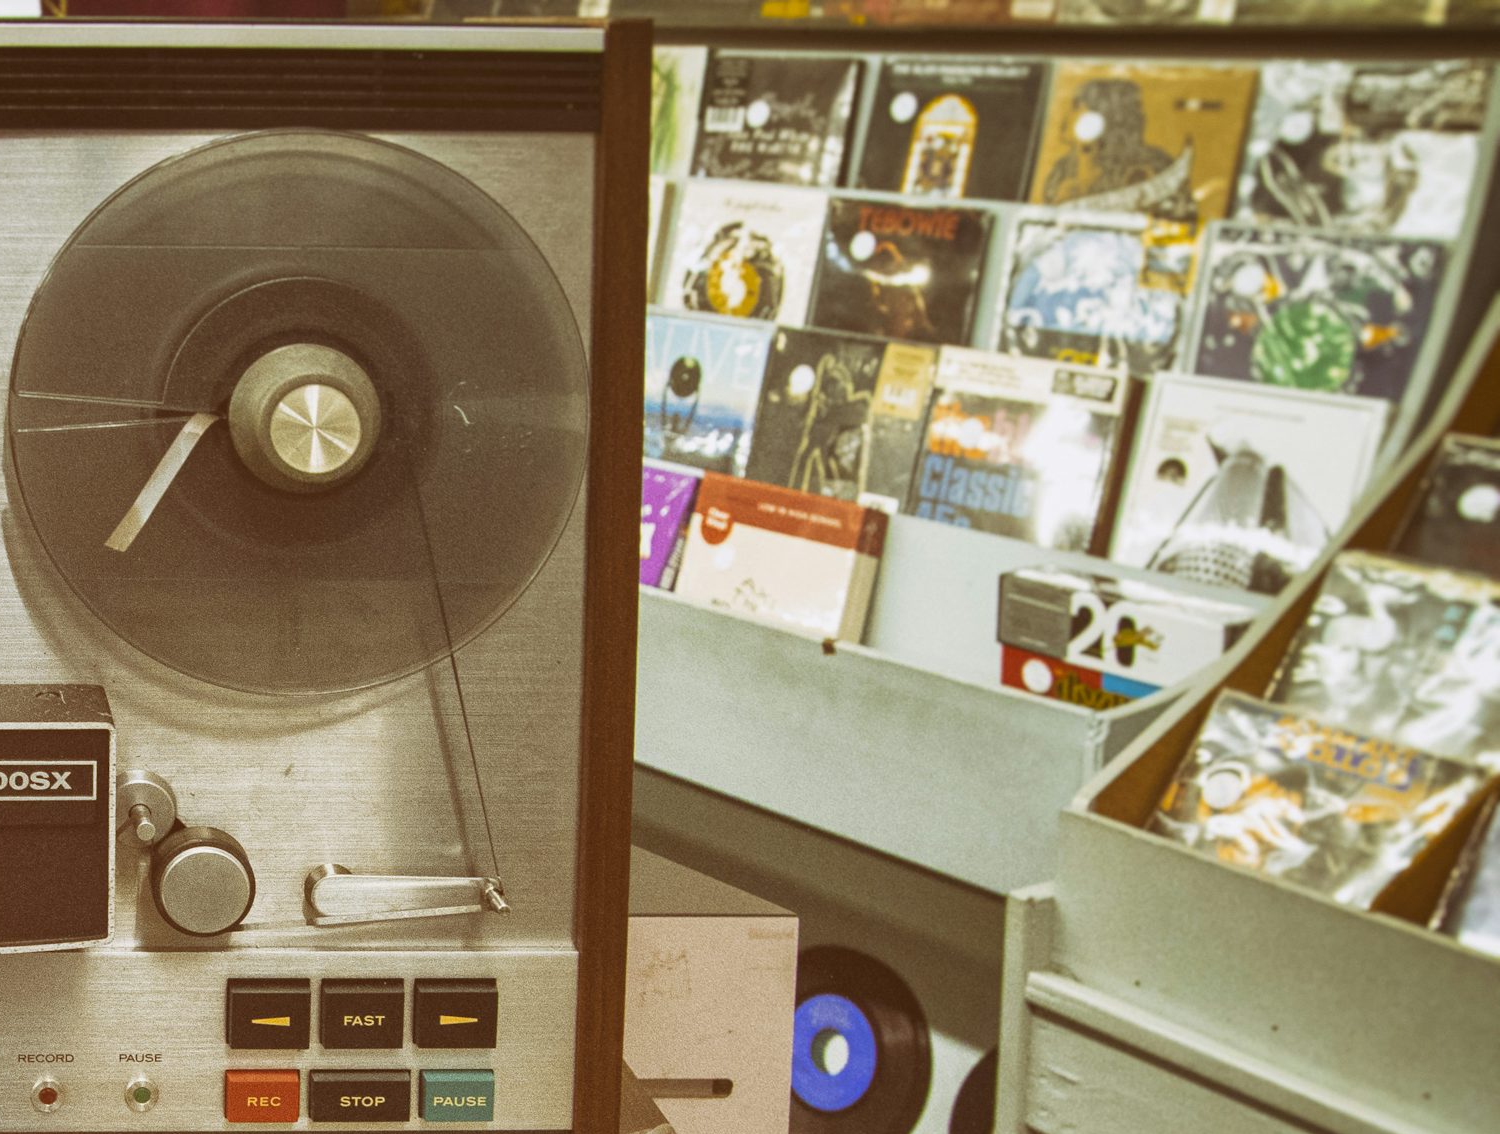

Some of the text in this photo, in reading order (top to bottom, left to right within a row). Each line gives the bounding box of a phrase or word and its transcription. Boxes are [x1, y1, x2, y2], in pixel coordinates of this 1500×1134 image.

[343, 1015, 385, 1026] FAST
[17, 1053, 75, 1063] RECORD
[118, 1053, 163, 1063] PAUSE
[247, 1096, 281, 1107] REC
[339, 1096, 386, 1107] STOP
[433, 1096, 487, 1107] PAUSE
